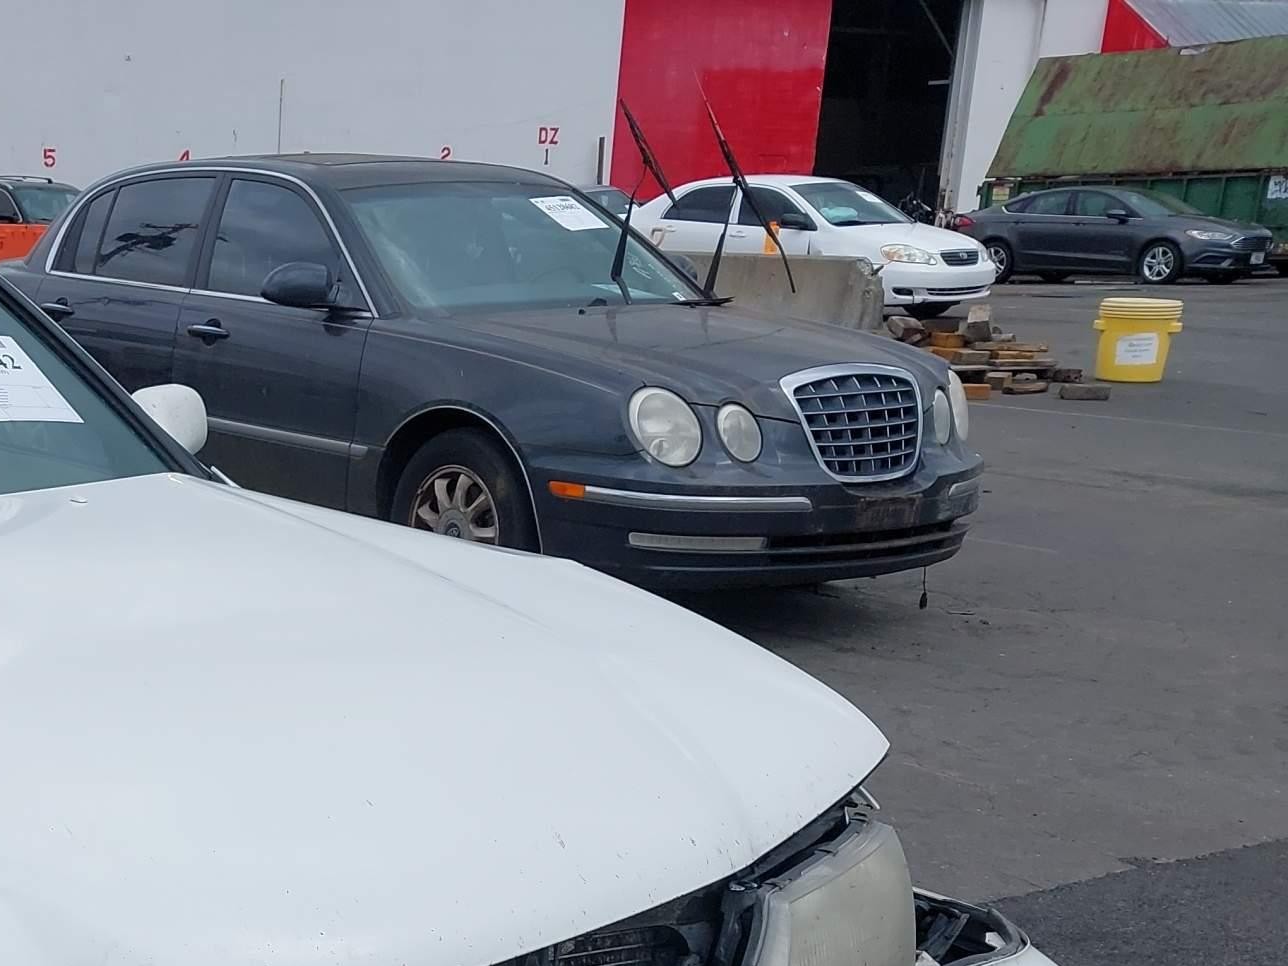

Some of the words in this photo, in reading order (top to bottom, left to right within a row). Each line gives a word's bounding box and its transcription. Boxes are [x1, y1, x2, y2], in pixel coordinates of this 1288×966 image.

[538, 127, 560, 145] DZ
[43, 148, 57, 168] 5
[440, 146, 452, 160] 2
